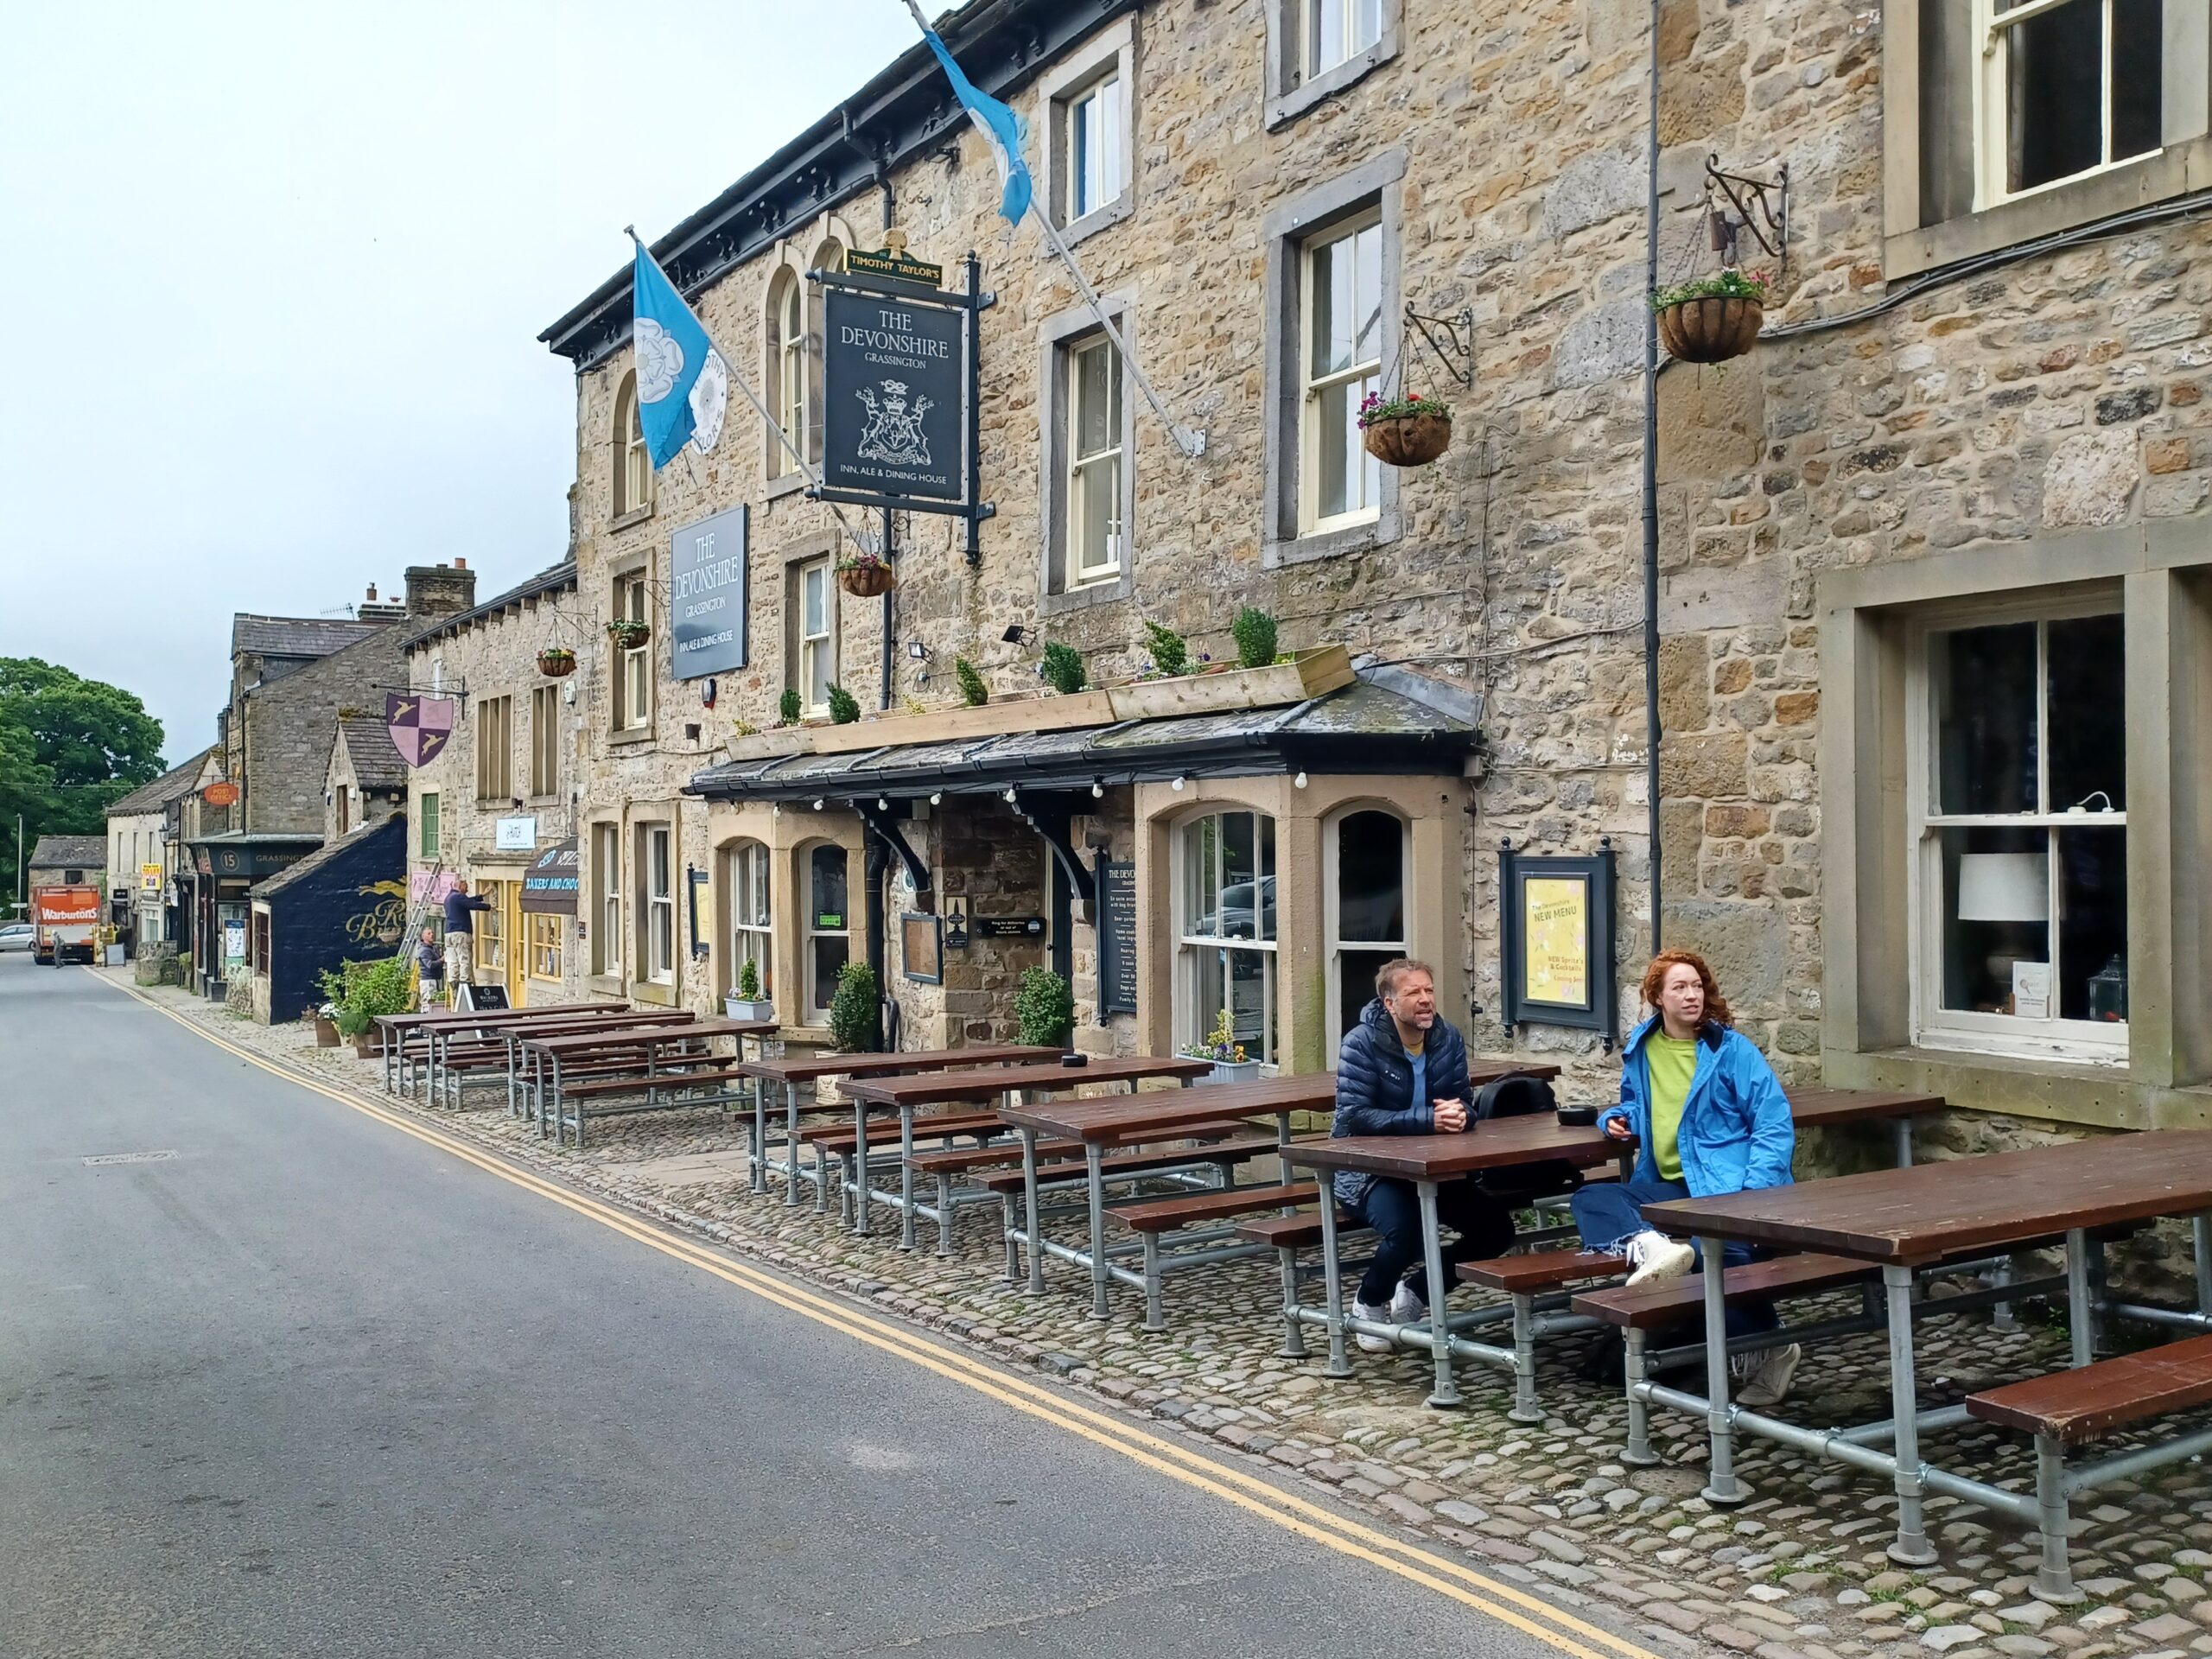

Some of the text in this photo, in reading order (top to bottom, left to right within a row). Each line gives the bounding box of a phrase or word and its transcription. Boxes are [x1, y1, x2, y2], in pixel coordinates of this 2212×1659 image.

[850, 255, 939, 278] TIMOTHY TAYLOR'S
[879, 310, 912, 332] THE
[841, 326, 949, 359] DEVONSHIRE
[865, 352, 927, 369] GRASSINGTON
[860, 467, 875, 476] ALE
[877, 468, 883, 477] &
[886, 469, 916, 481] DINING
[918, 474, 947, 485] HOUSE
[696, 532, 715, 563] THE
[675, 556, 738, 600] DEVONSHIRE
[685, 595, 726, 618] GRASSINGTON
[701, 633, 717, 647] DINING
[717, 629, 733, 644] HOUSE
[224, 854, 235, 867] 15
[1109, 869, 1119, 878] THE
[548, 878, 562, 890] AND
[41, 907, 97, 920] Warburtons
[1535, 906, 1577, 922] NEW MENU
